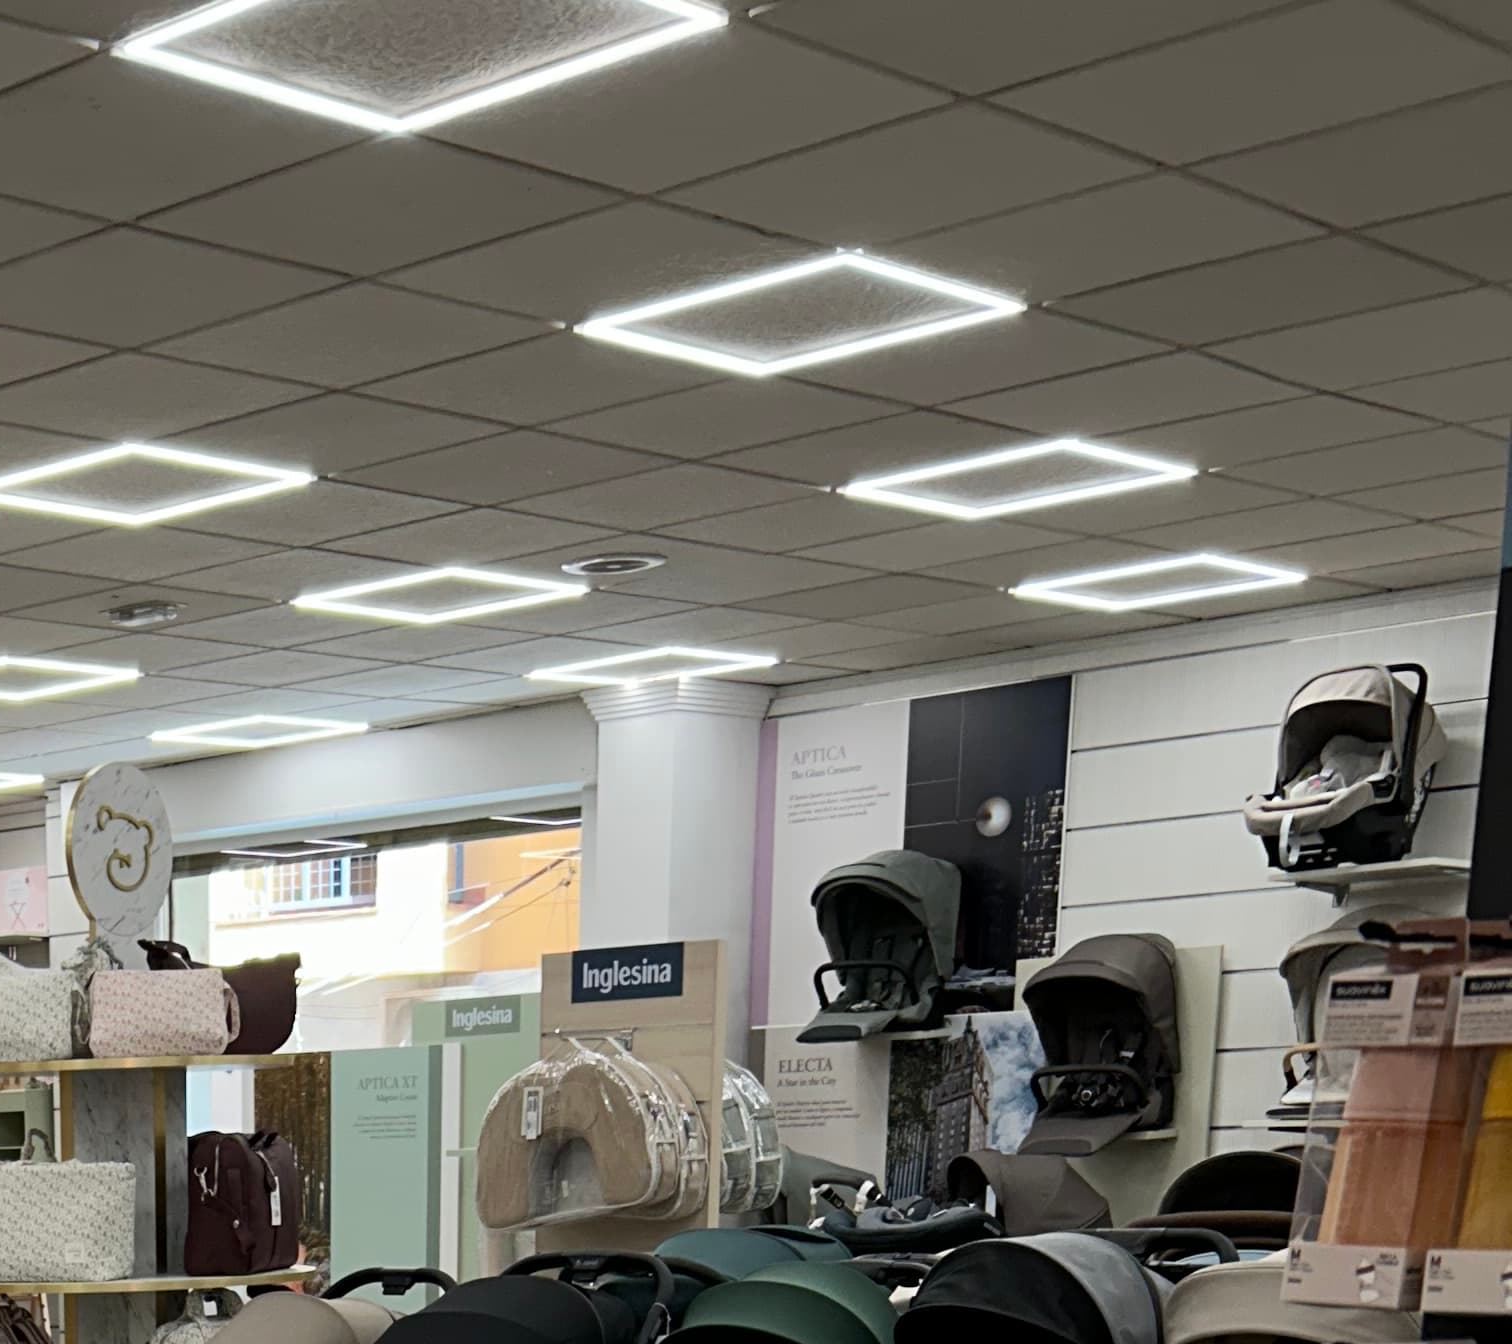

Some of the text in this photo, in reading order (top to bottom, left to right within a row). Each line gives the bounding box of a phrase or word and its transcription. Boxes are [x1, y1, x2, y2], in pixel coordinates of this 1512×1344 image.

[581, 957, 672, 995] Inglesina
[452, 1004, 513, 1032] Inglesina
[778, 1056, 833, 1074] ELECTA
